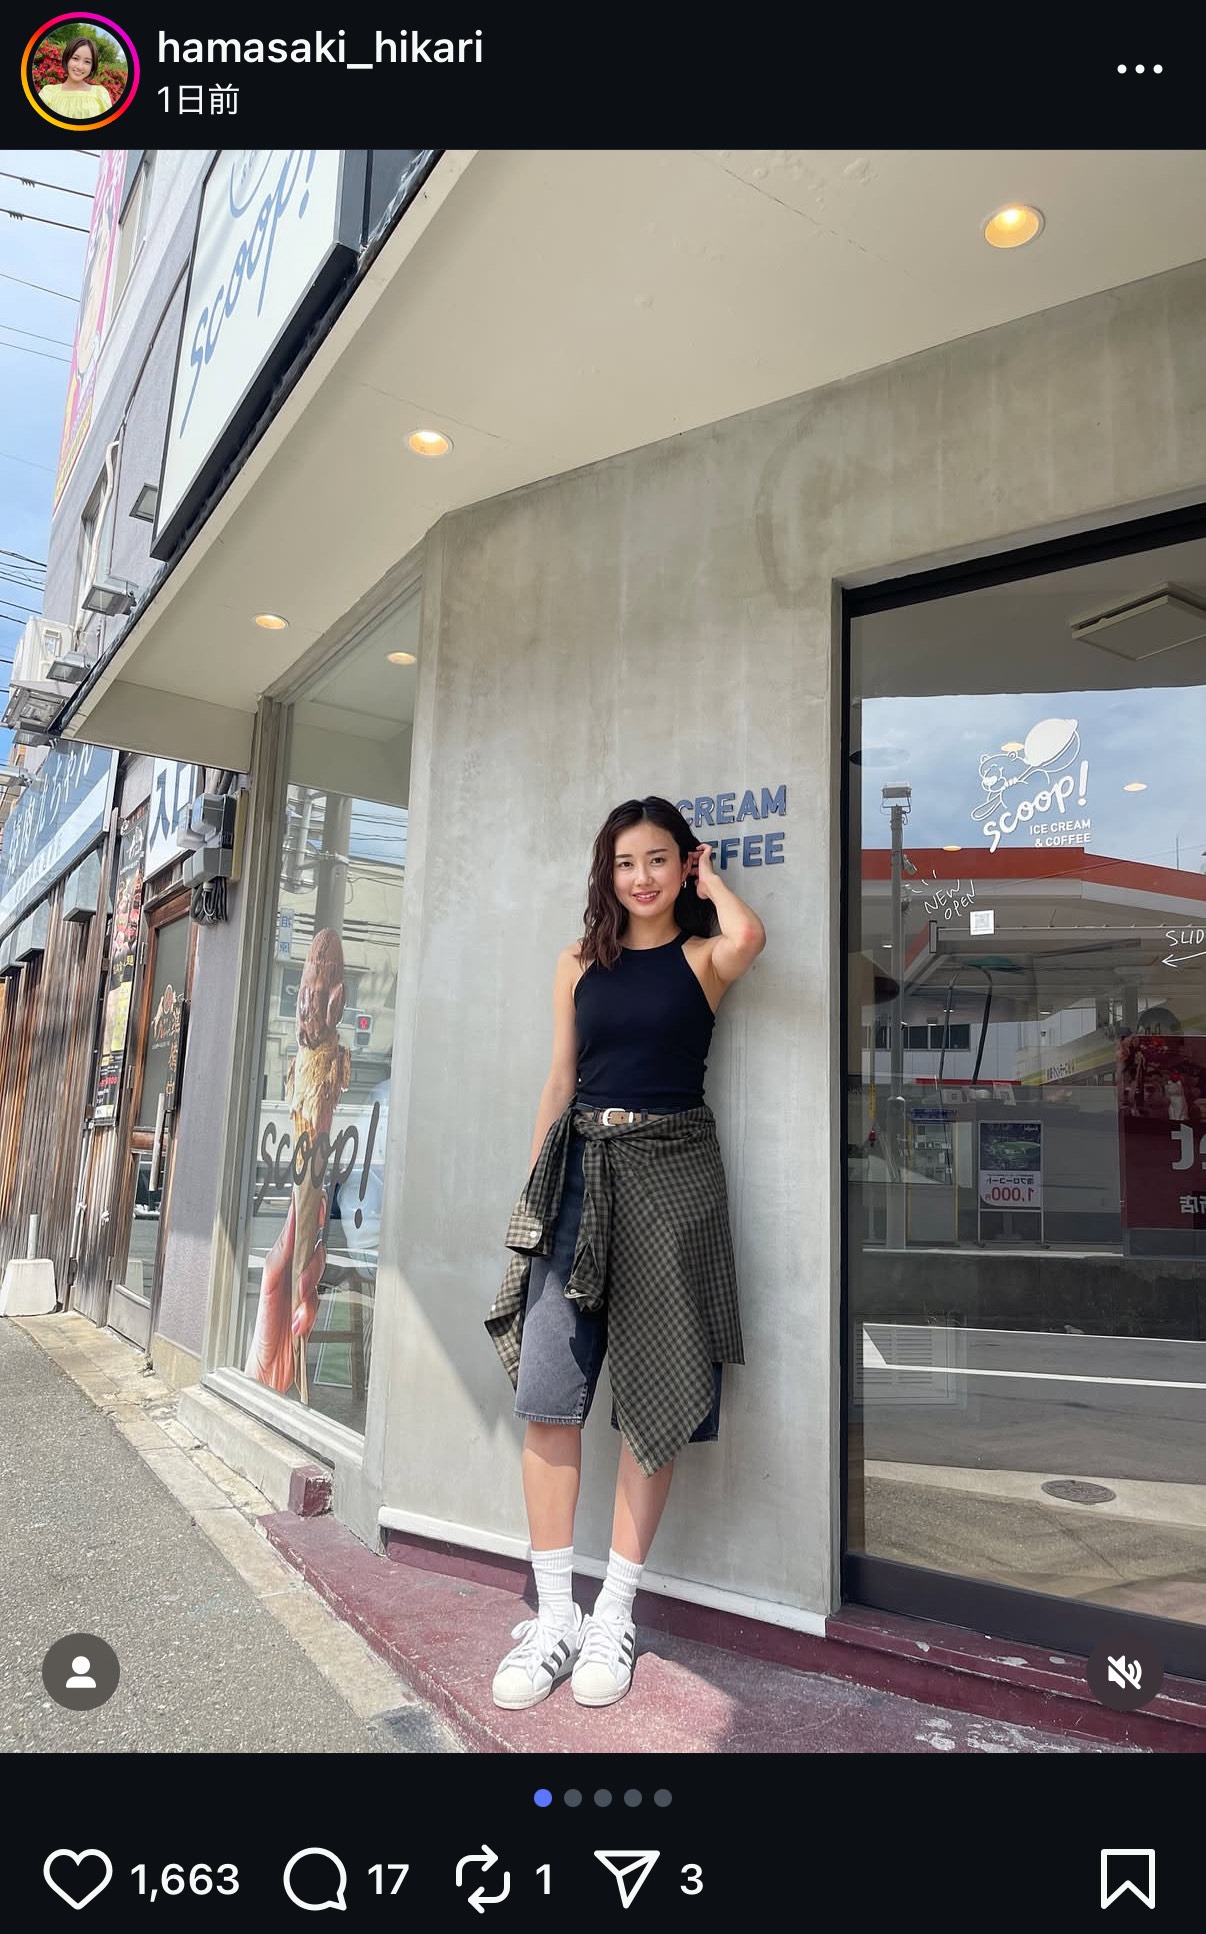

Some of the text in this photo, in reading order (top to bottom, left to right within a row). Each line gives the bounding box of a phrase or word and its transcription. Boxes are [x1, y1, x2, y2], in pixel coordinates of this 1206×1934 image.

[675, 784, 787, 828] CREAM
[983, 760, 1089, 853] scoop!
[1030, 819, 1091, 835] ICE CREAM
[1034, 833, 1092, 848] & COFFEE
[924, 879, 960, 914] NEW
[944, 879, 975, 920] OPEN
[1165, 928, 1205, 947] SLID
[252, 1101, 380, 1231] scoop!
